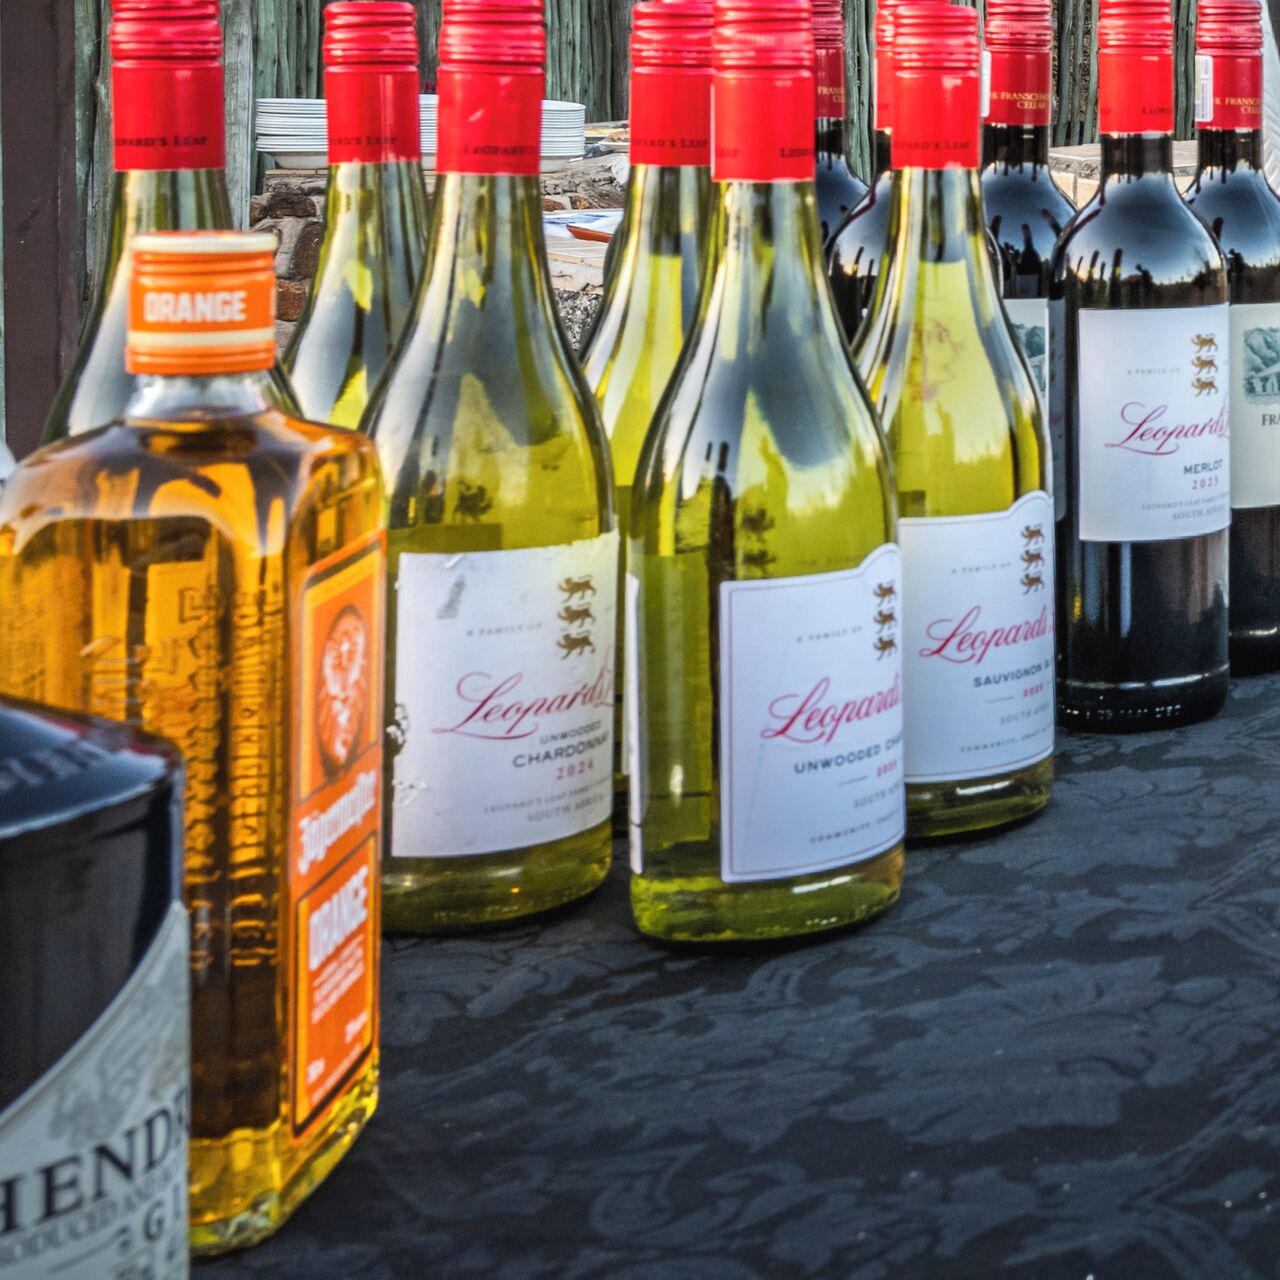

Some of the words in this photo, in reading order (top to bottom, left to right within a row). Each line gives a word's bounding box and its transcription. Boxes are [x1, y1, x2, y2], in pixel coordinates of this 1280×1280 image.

[143, 290, 248, 323] ORANGE
[1183, 459, 1223, 476] MERLOT
[478, 625, 523, 636] FAMILY
[973, 663, 1042, 688] SAUVIGNON
[793, 744, 881, 774] UNWOODED
[308, 865, 369, 971] ORANGE
